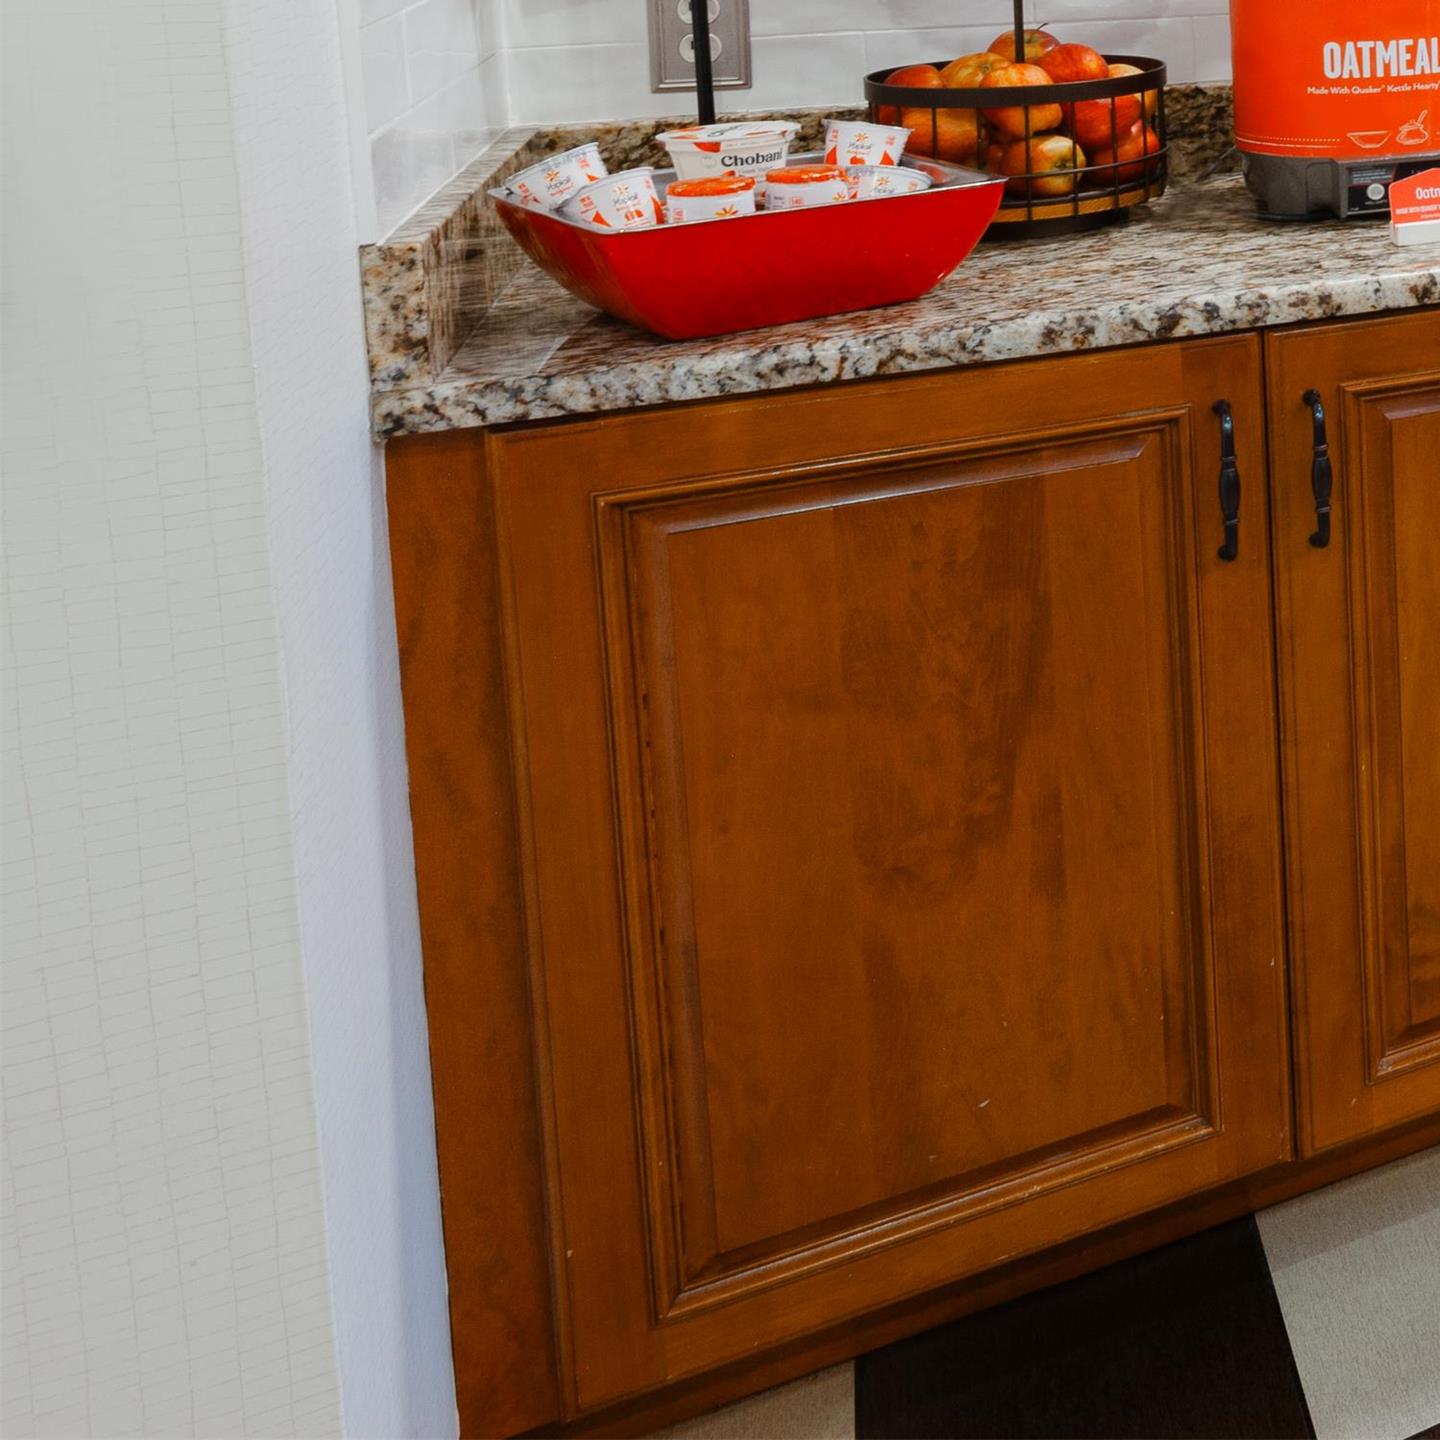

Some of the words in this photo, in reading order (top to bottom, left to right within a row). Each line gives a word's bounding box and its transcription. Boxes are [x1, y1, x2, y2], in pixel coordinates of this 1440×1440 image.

[1307, 86, 1329, 95] Made
[1329, 86, 1350, 95] With
[721, 148, 784, 168] Chobani
